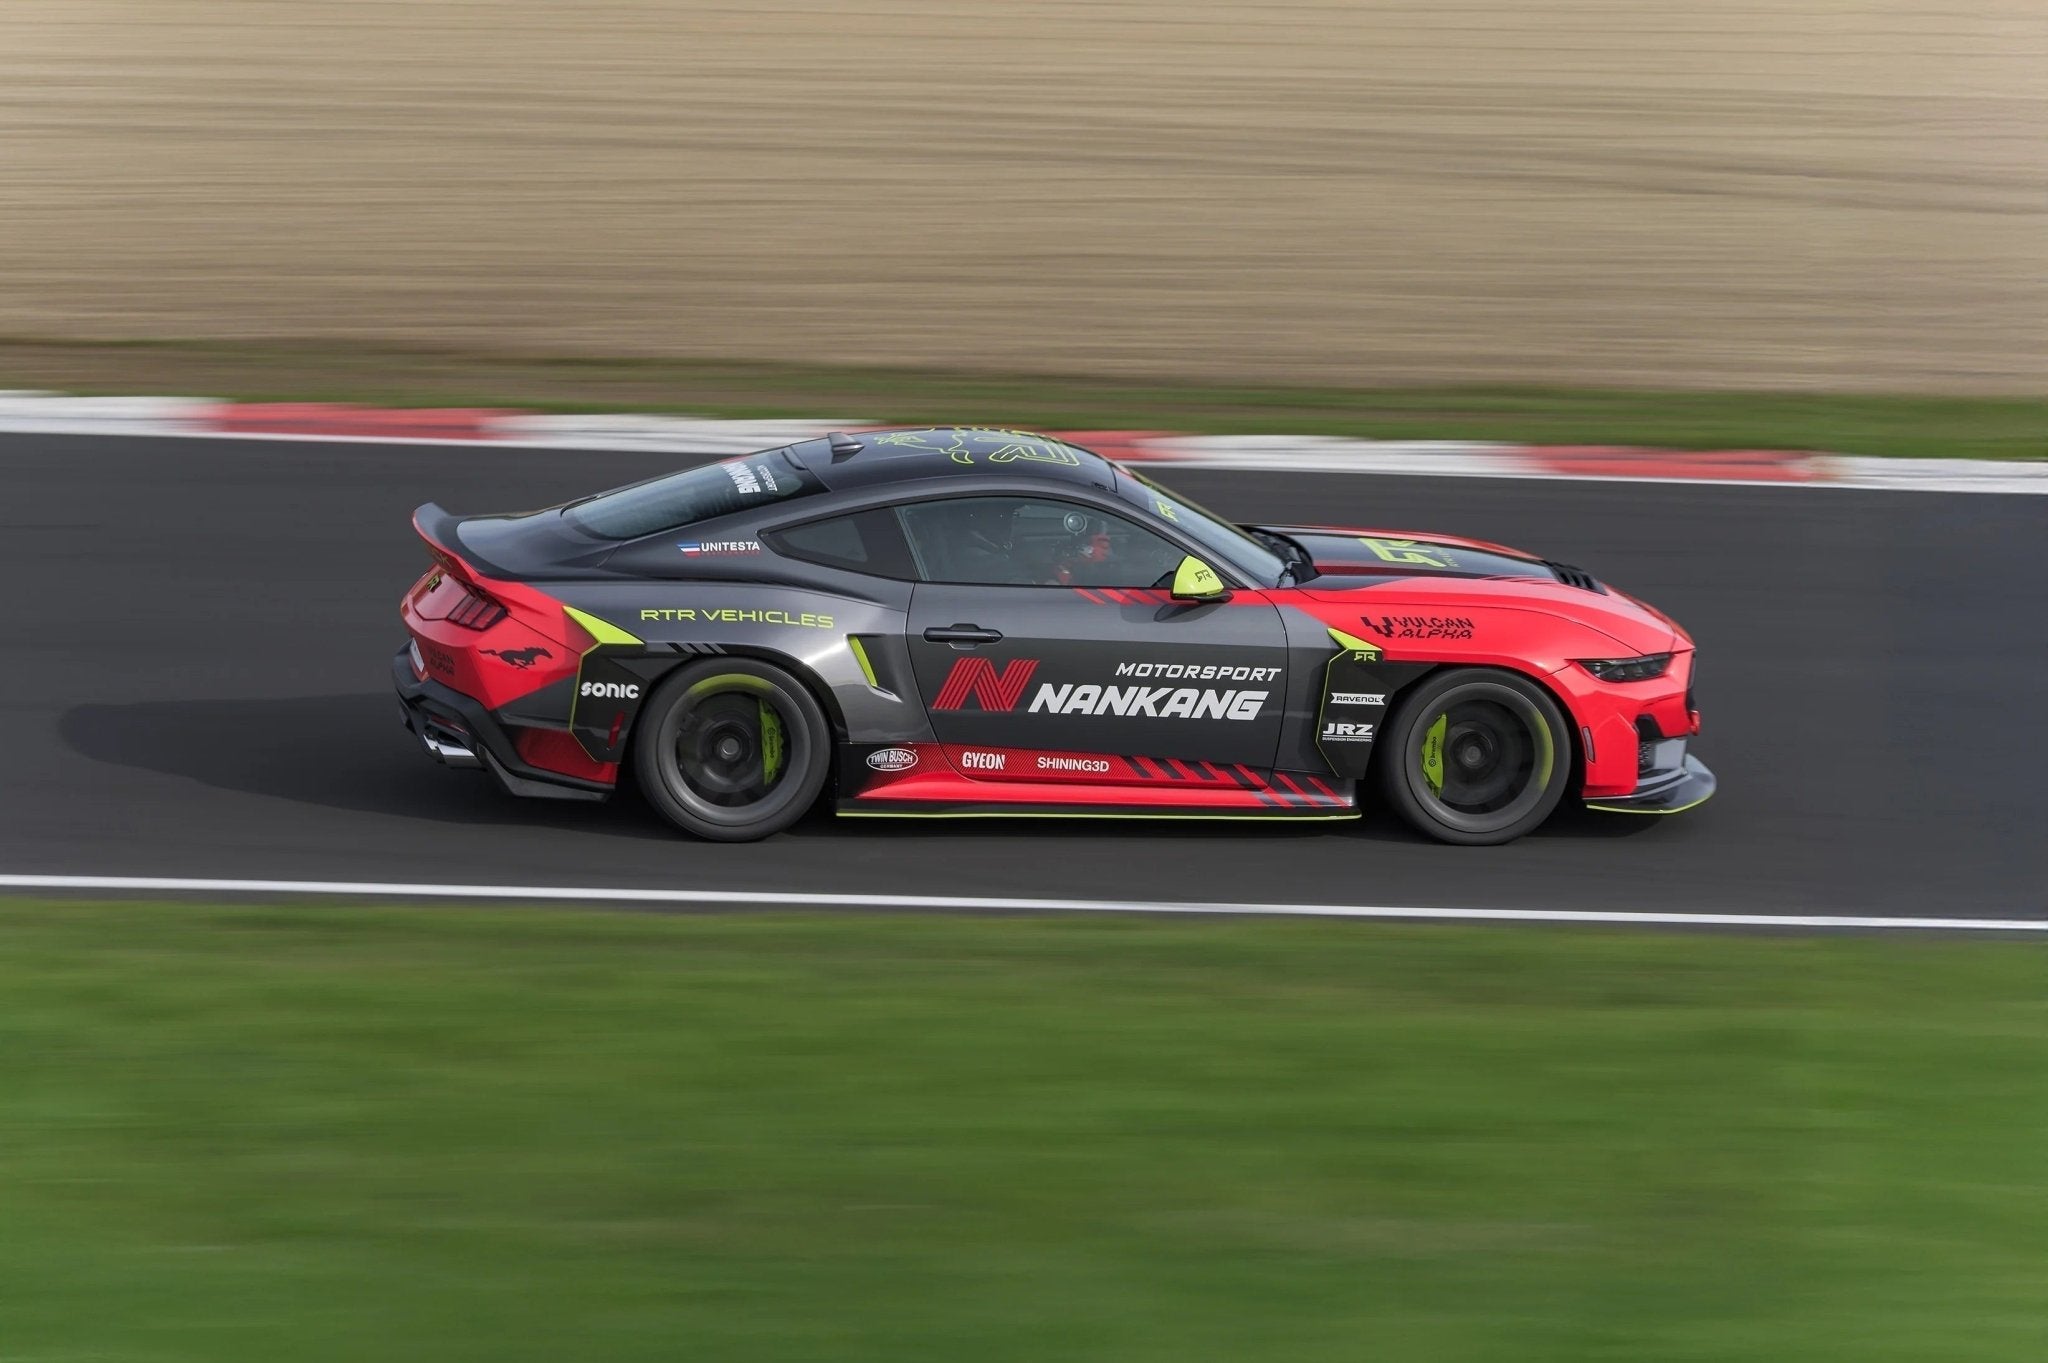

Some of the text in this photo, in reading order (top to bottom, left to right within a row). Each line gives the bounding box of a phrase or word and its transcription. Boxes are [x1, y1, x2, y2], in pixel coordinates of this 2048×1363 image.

[721, 461, 761, 493] NKANG
[701, 541, 761, 552] UNITESTA
[641, 609, 834, 629] RTR VEHICLES
[1392, 616, 1475, 629] VULCAN
[1398, 628, 1472, 639] ALPHA
[1115, 662, 1282, 682] MOTORSPORT
[1028, 683, 1269, 721] NANKANG
[1335, 695, 1381, 703] RAVENOL
[1322, 722, 1374, 736] JRZ
[870, 750, 913, 764] TWIN BUSCH
[962, 751, 1006, 770] GYEON
[1037, 756, 1110, 773] SHINING3D
